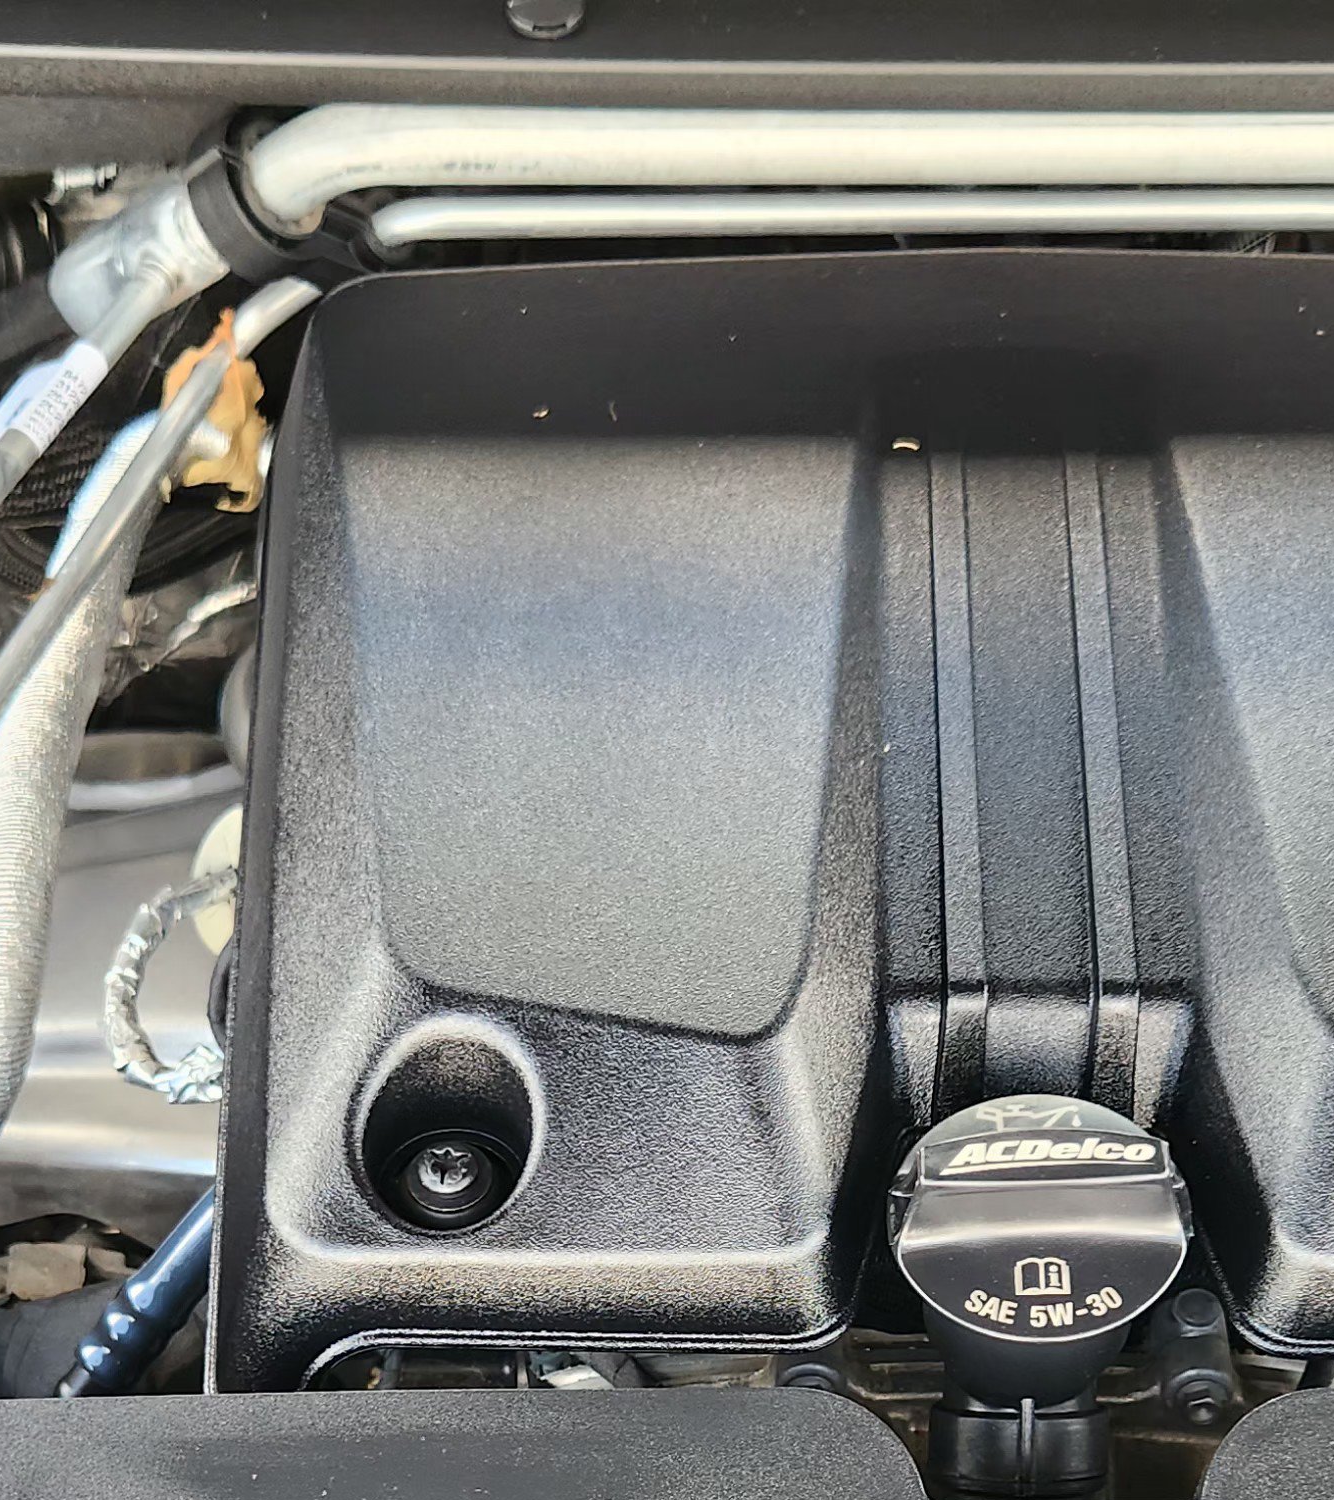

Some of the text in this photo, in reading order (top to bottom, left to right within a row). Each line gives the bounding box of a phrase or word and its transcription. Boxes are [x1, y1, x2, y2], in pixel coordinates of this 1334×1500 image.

[948, 1137, 1156, 1168] ACDelco
[964, 1286, 1123, 1328] SAE 5W-30
